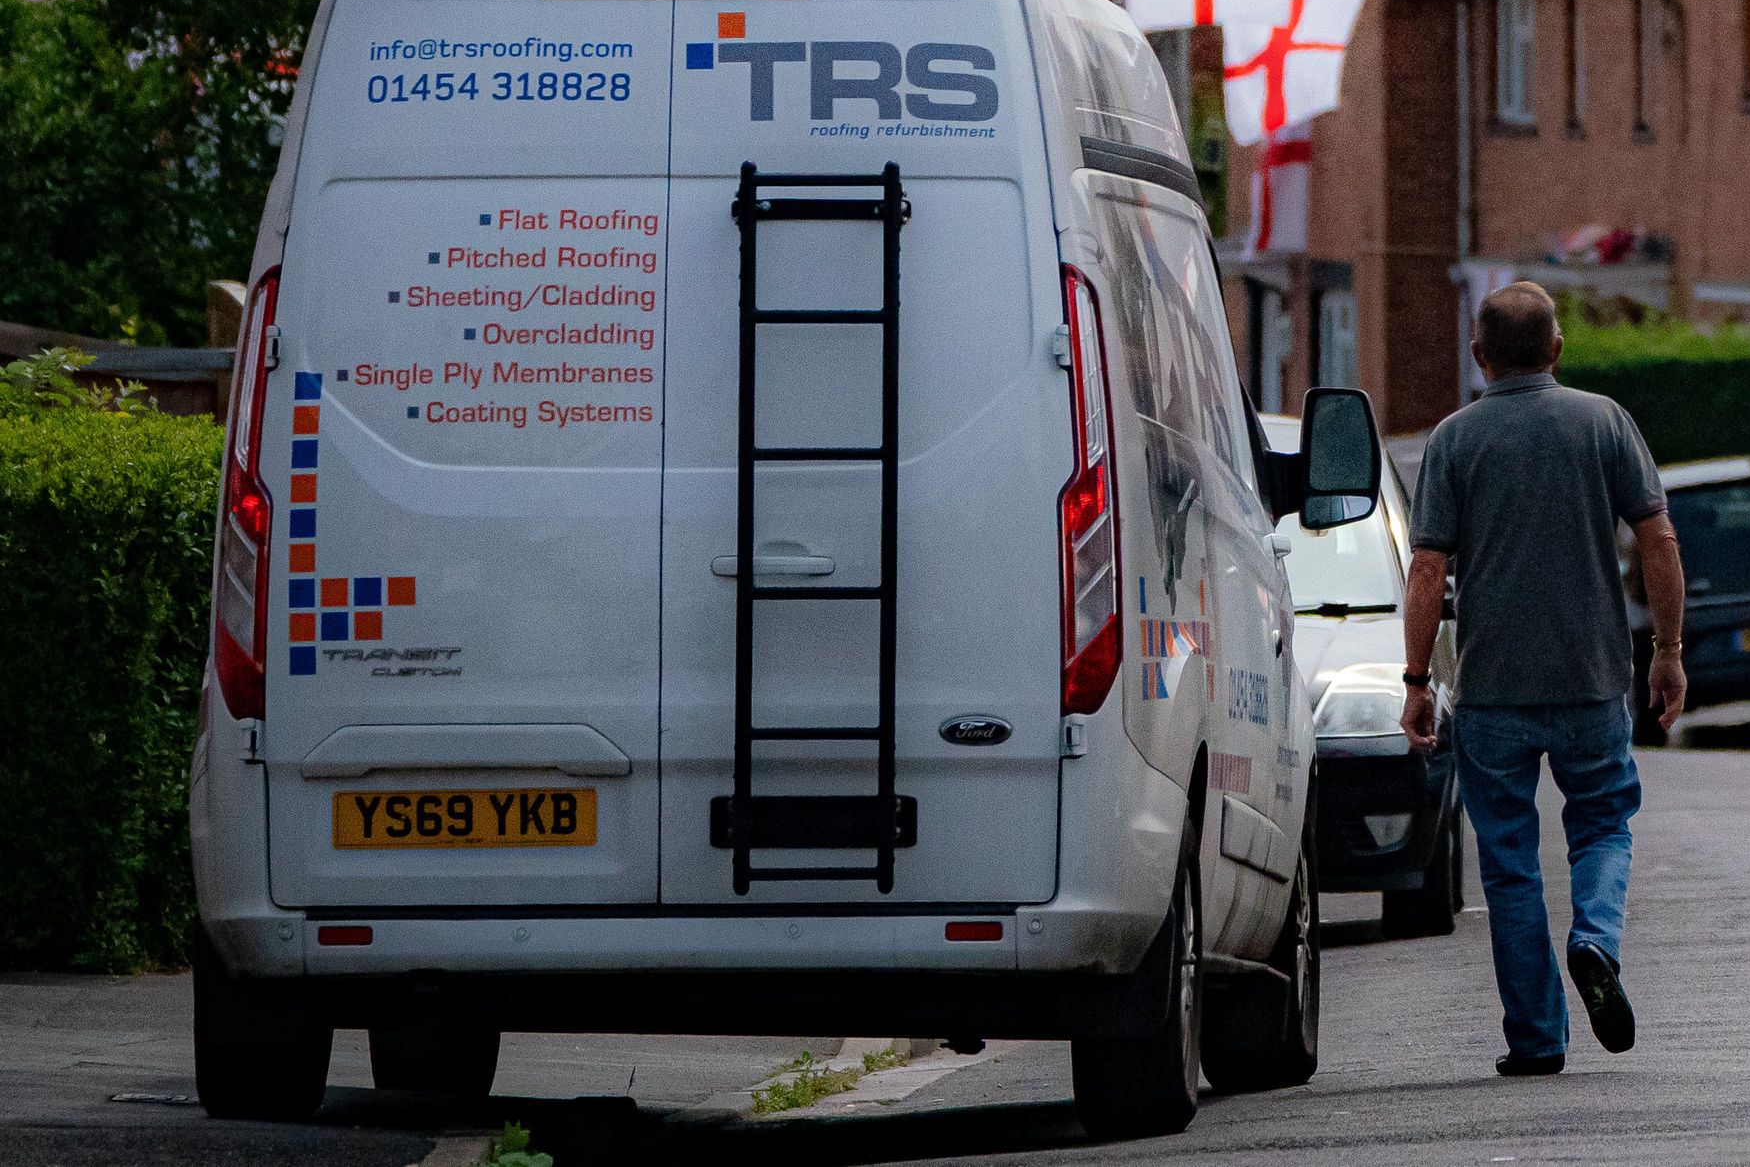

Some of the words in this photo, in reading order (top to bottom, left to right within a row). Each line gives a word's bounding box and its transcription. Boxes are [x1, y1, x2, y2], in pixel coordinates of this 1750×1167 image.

[370, 36, 633, 63] info@trsroofing.com
[367, 73, 479, 103] 01454
[491, 72, 631, 102] 318828
[717, 41, 999, 122] TRS
[810, 123, 869, 140] roofing
[876, 123, 996, 139] refurbishment
[498, 208, 548, 231] Flat
[558, 208, 660, 237] Roofing
[446, 246, 546, 269] Pitched
[557, 245, 657, 274] Roofing
[406, 284, 656, 312] Sheeting/Cladding
[482, 322, 655, 350] Overcladding
[354, 362, 433, 392] Single
[443, 362, 483, 391] Ply
[492, 360, 654, 385] Membranes
[425, 400, 528, 429] Coating
[537, 399, 653, 429] Systems
[354, 794, 474, 839] YS69
[488, 792, 578, 836] YKB
